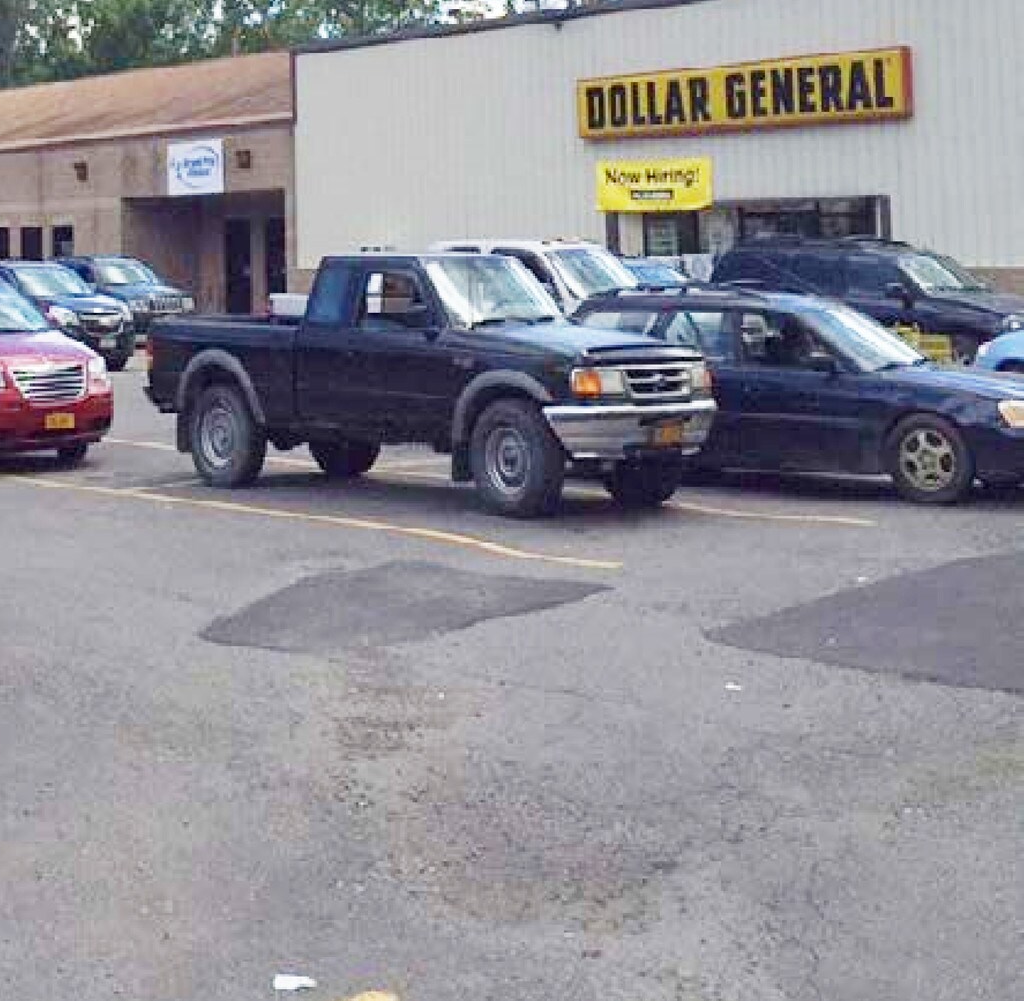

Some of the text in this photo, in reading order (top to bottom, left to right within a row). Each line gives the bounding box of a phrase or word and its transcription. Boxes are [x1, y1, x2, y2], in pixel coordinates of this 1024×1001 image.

[585, 57, 894, 130] DOLLAR GENERAL
[605, 167, 700, 189] Now Hiring!
